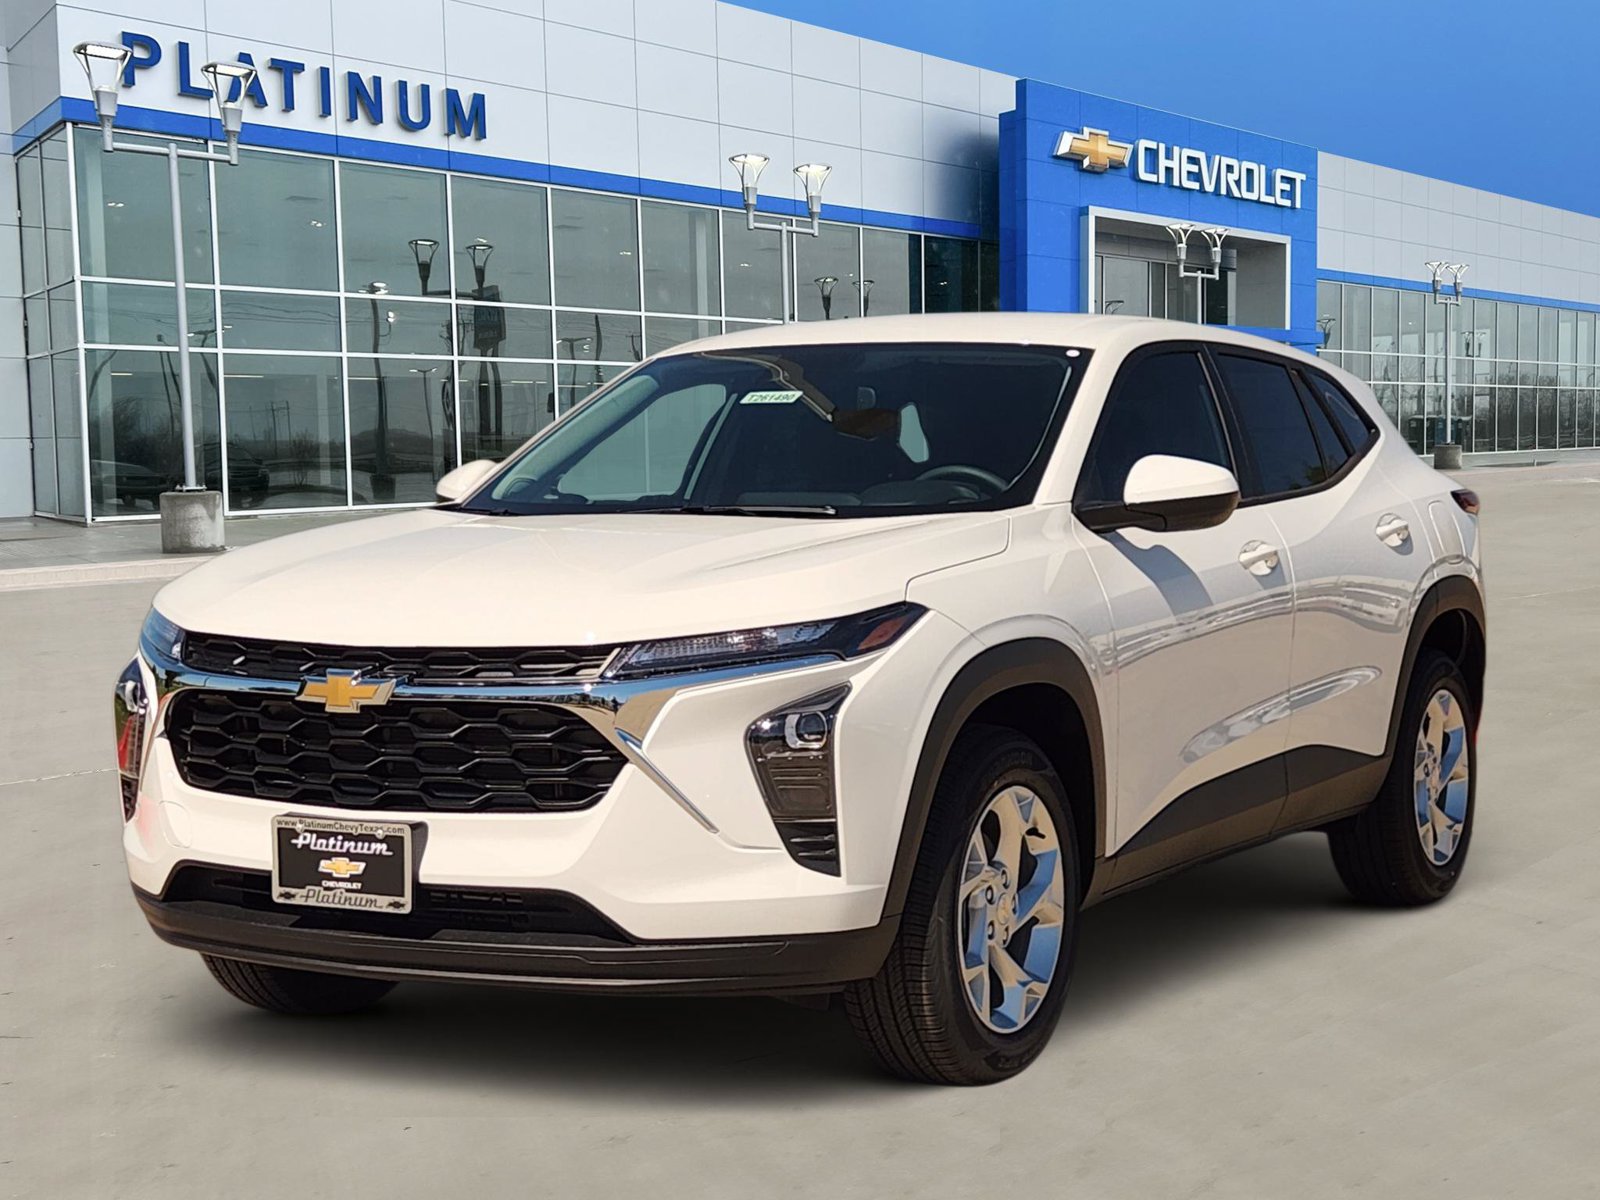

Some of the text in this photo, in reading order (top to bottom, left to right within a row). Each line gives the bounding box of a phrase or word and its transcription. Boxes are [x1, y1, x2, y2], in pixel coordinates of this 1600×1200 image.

[120, 31, 487, 140] PLATINUM
[1137, 139, 1306, 209] CHEVROLET
[276, 818, 405, 834] wwwPlatinumChevyTexa.com
[290, 832, 393, 855] Platinum
[321, 880, 362, 890] CHEVROLET
[300, 888, 384, 909] Platinum
